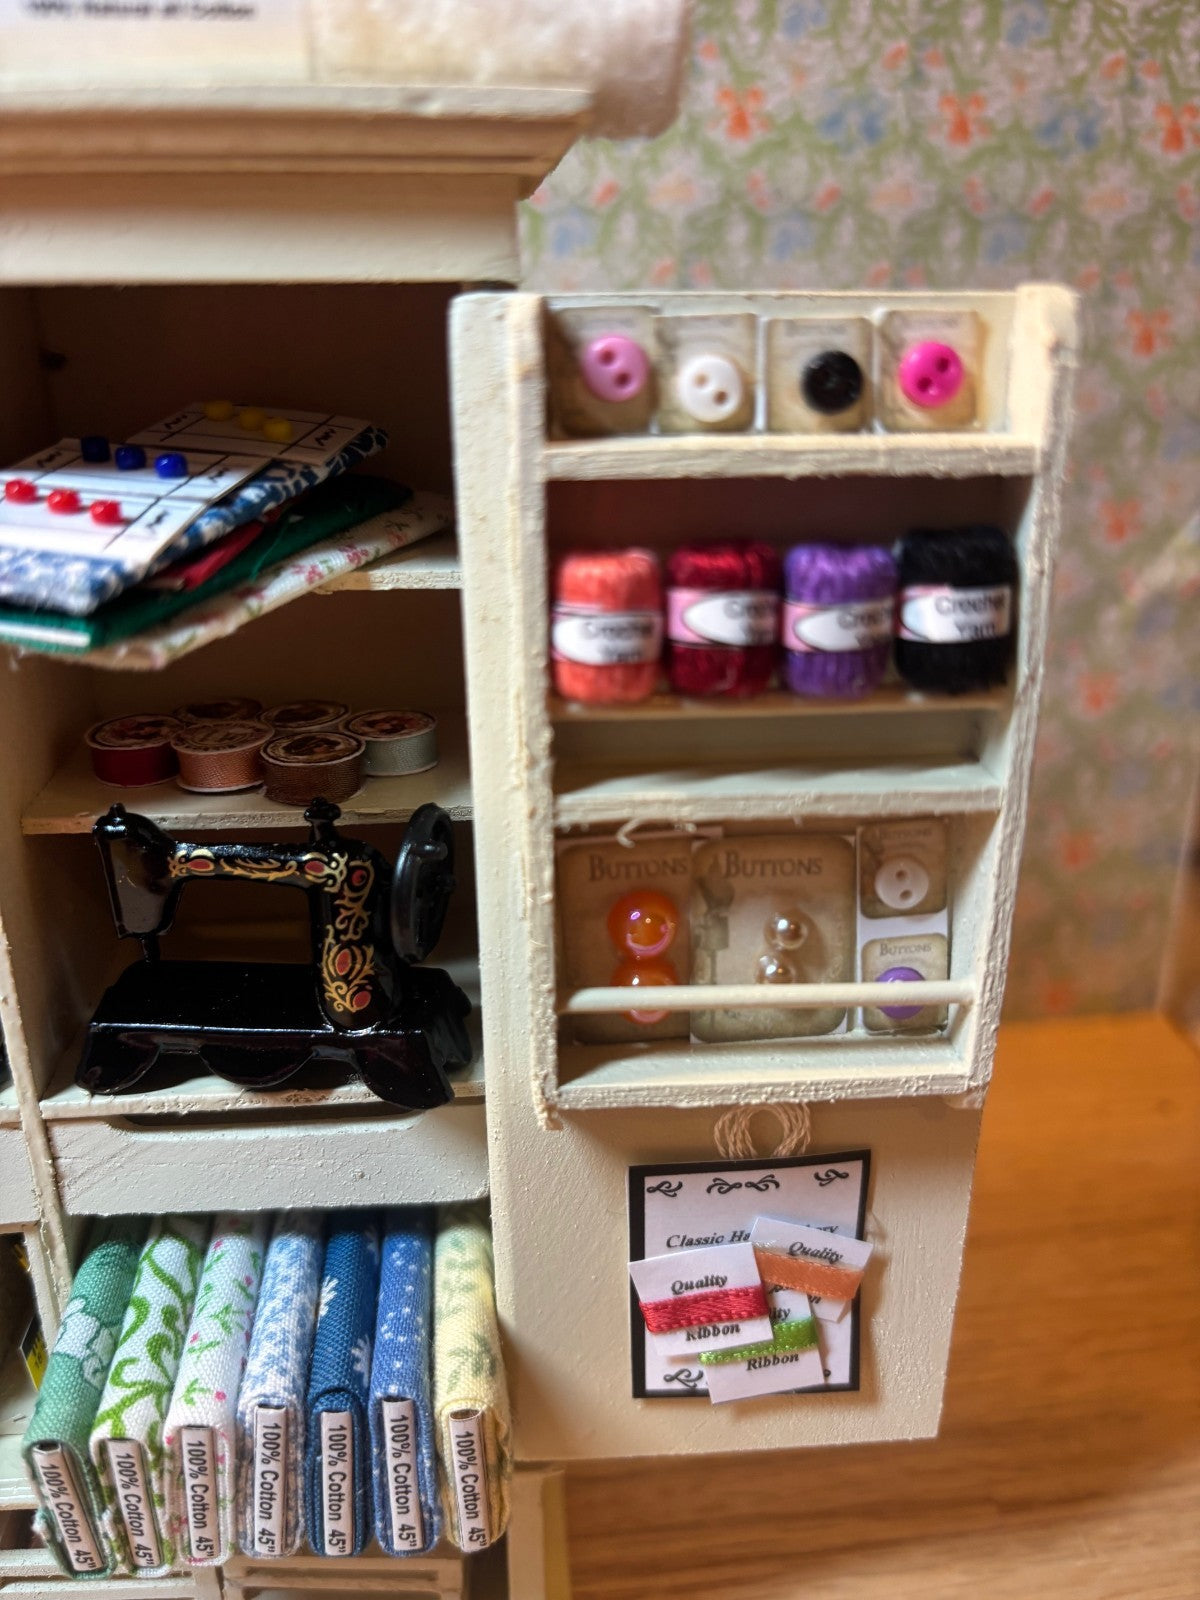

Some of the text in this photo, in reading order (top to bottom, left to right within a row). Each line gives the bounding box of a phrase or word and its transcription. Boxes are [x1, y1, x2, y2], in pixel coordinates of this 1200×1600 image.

[589, 854, 689, 882] BUTTONS
[722, 850, 824, 878] BUTTONS
[879, 941, 933, 958] BUTTONS
[665, 1231, 725, 1249] Classic
[788, 1240, 844, 1264] Quality
[670, 1273, 729, 1296] Quality
[685, 1323, 741, 1342] Ribbon
[746, 1353, 800, 1372] Ribbon
[260, 1422, 283, 1465] 100%
[327, 1424, 348, 1467] 100%
[390, 1414, 411, 1459] 100%
[454, 1431, 478, 1471] 100%
[115, 1452, 140, 1489] 100%
[186, 1439, 209, 1479] 100%
[40, 1462, 68, 1500] 100%
[55, 1502, 83, 1543] Cotton
[190, 1484, 210, 1530] Cotton
[258, 1469, 279, 1520] Cotton
[328, 1471, 347, 1521] Cotton
[392, 1463, 413, 1516] Cotton
[460, 1473, 480, 1520] Cotton
[123, 1493, 146, 1537] Cotton
